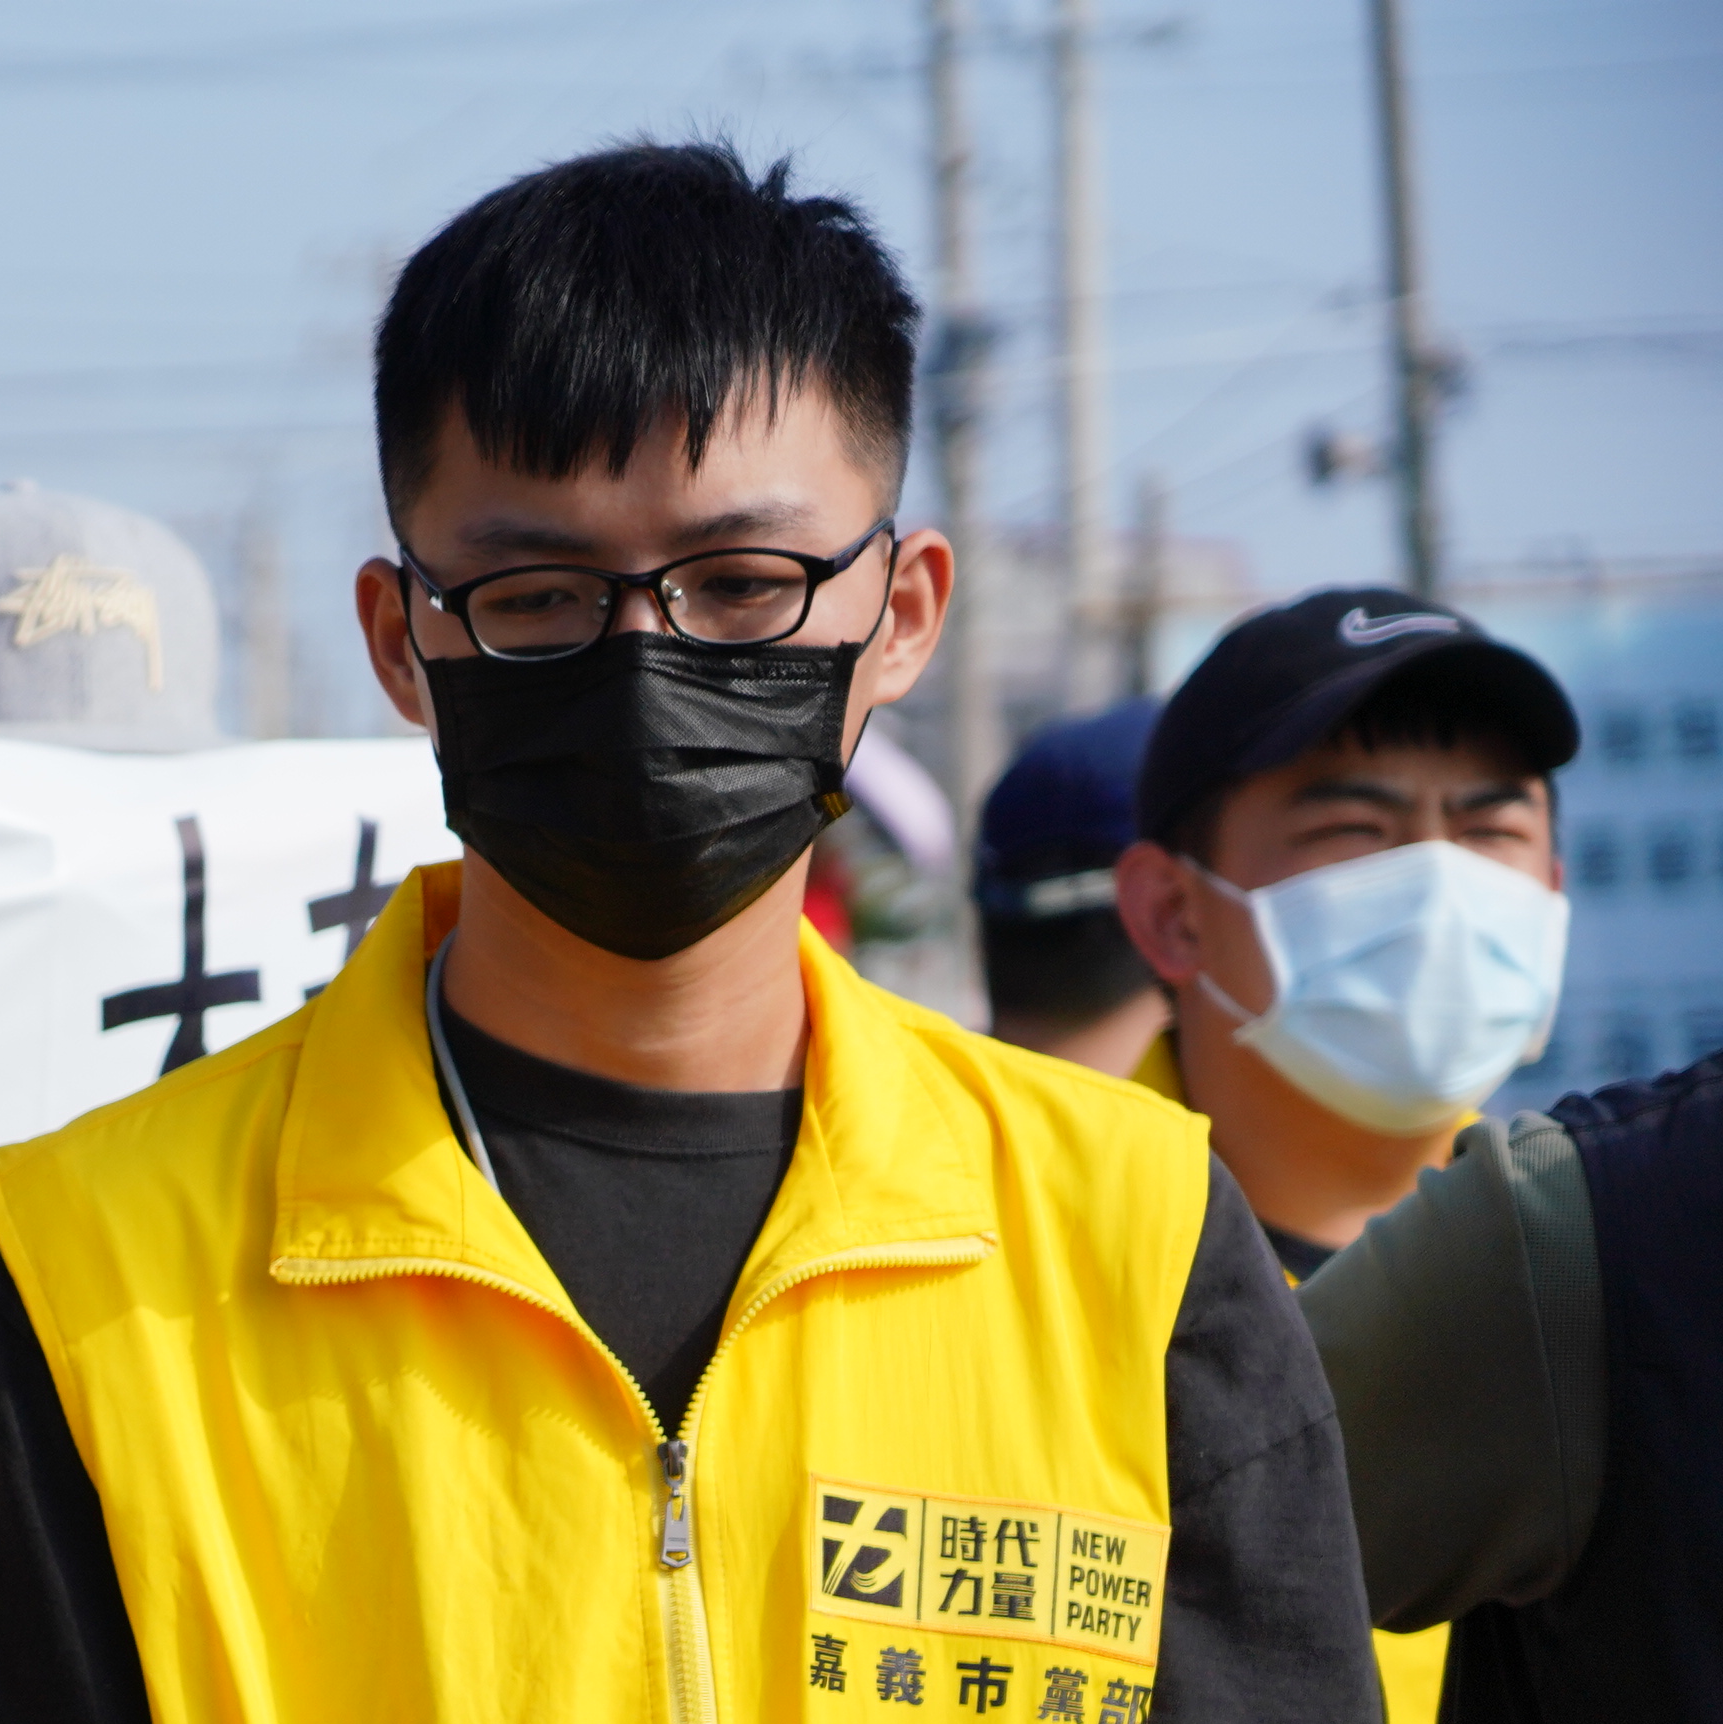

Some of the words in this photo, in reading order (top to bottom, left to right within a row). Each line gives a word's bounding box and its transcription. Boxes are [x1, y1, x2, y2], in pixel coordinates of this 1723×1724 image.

[939, 1515, 1041, 1568] 時代
[1071, 1528, 1127, 1566] NEW
[938, 1568, 1036, 1621] 力量
[1069, 1564, 1152, 1608] POWER
[1066, 1600, 1142, 1643] PARTY
